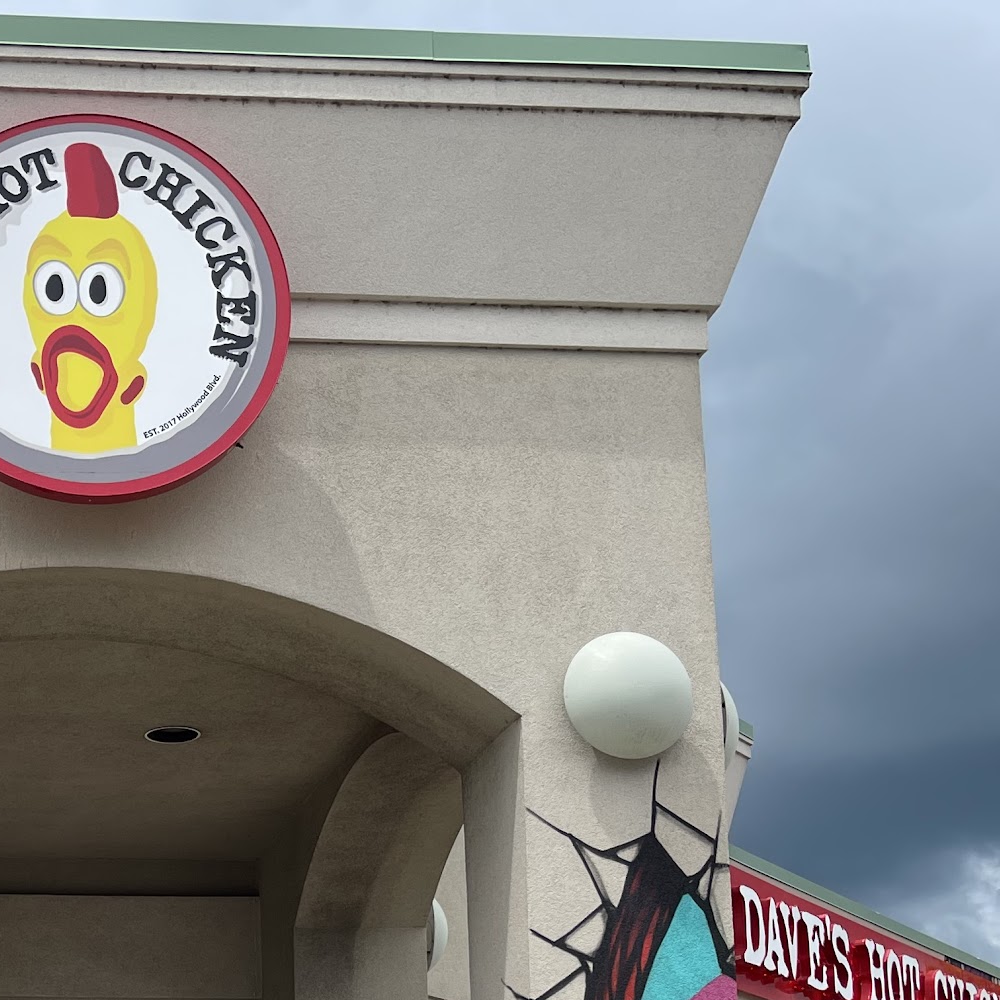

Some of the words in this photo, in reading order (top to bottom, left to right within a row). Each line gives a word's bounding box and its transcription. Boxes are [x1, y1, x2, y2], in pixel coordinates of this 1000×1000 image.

[118, 151, 257, 368] CHICKEN
[143, 428, 160, 438] EST.
[159, 418, 177, 432] 2017
[176, 390, 209, 421] Hollywood
[206, 374, 221, 391] Blvd.
[740, 885, 854, 1000] DAVE'S
